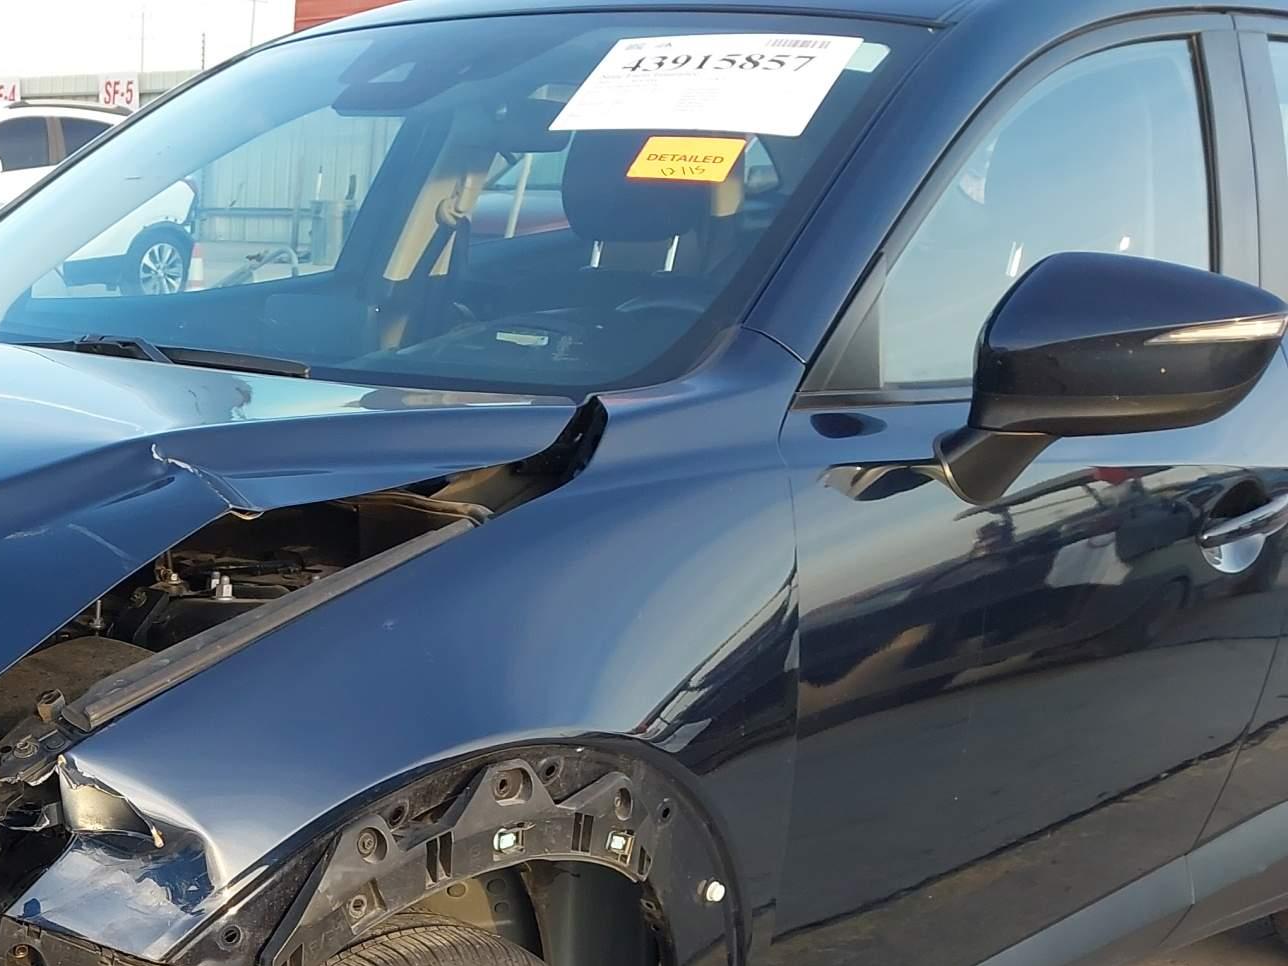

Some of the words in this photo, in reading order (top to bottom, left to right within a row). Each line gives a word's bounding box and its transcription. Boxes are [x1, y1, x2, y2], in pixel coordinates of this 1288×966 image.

[622, 53, 816, 72] 43915857
[104, 79, 134, 105] SF-5
[647, 153, 725, 164] DETAILED
